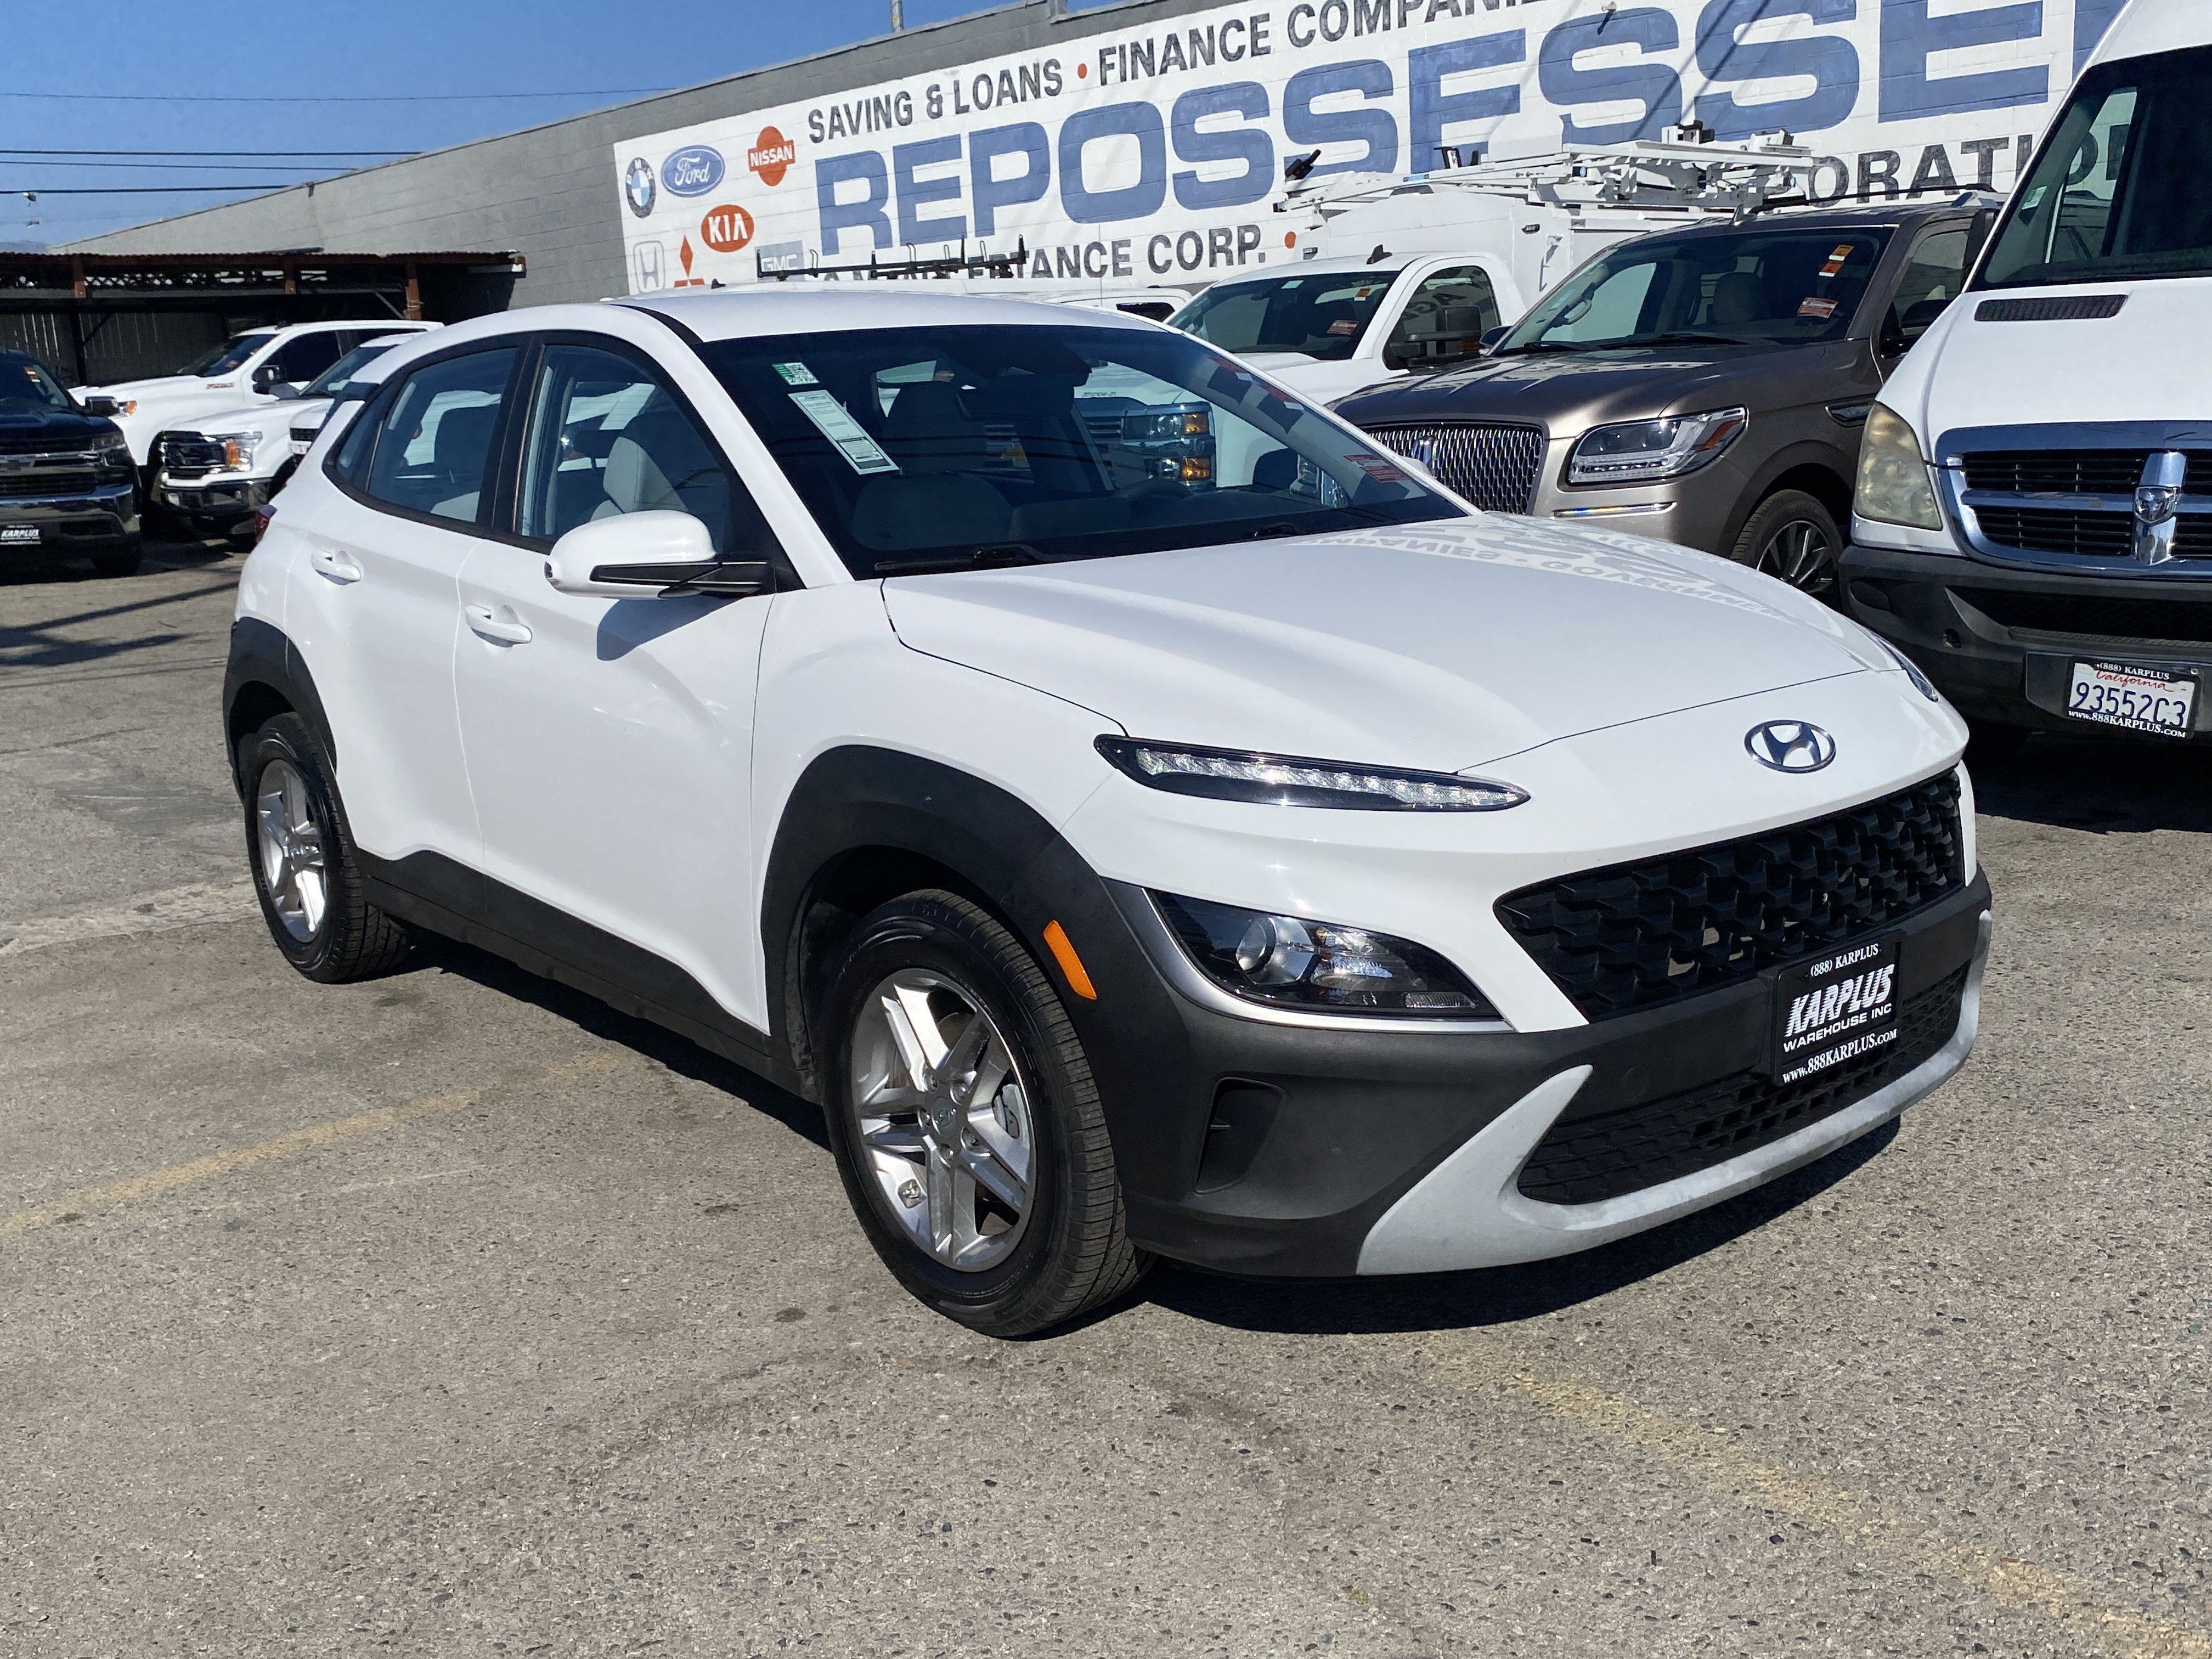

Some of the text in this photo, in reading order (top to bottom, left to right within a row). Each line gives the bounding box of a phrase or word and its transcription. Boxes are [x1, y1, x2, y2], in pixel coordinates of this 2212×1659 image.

[808, 91, 913, 143] SAVING
[926, 83, 943, 119] &
[953, 58, 1063, 114] LOANS
[1099, 13, 1271, 86] FINANCE
[674, 156, 710, 186] Ford
[749, 144, 793, 167] NISSAN
[708, 213, 748, 243] KIA
[760, 254, 799, 271] GMC
[1148, 224, 1266, 274] CORP.
[2095, 670, 2173, 692] California
[2100, 662, 2170, 680] (888) KARPLUS
[2073, 682, 2186, 728] 93552C3
[1810, 944, 1878, 978] (888) KARPLUS
[1784, 964, 1895, 1037] KARPLUS
[1783, 1003, 1892, 1052] WAREHOUSE INC
